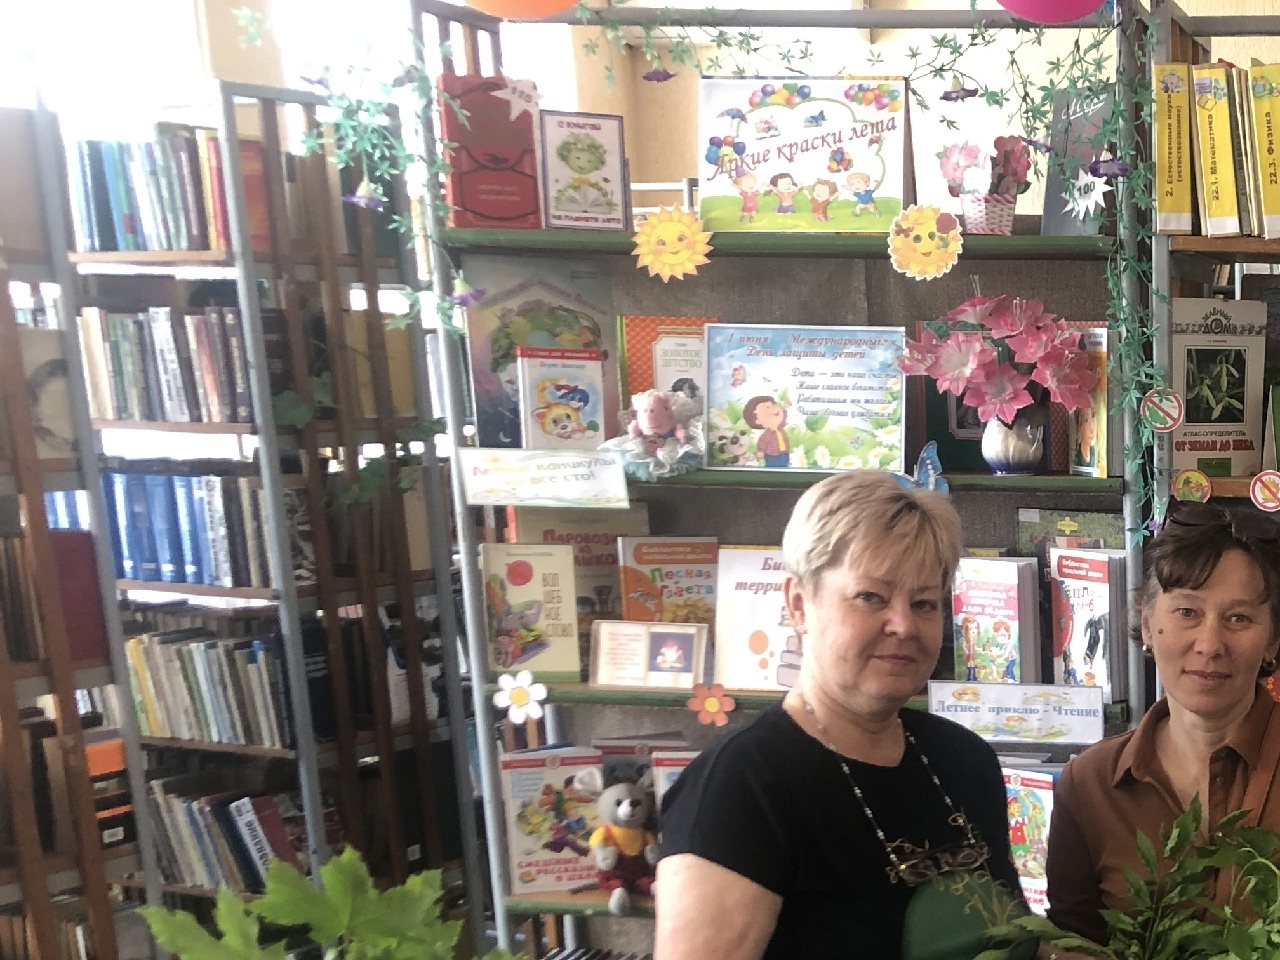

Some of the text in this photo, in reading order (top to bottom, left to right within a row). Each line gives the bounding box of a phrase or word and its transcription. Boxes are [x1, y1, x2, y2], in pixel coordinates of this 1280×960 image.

[707, 116, 897, 181] Яркие краски лета
[1207, 113, 1218, 175] Математика
[1265, 111, 1278, 185] 22.3. Физика
[1077, 181, 1096, 197] 100
[739, 334, 770, 344] июня
[784, 333, 892, 346] Международны
[746, 346, 867, 360] День защиты детей
[1183, 430, 1247, 438] АТЛАС-ОПРЕДЕЛИТЕЛЬ
[543, 529, 627, 544] ПАРОВОЗИ
[542, 572, 560, 587] ВОЛ
[935, 701, 1099, 717] Летнее приклю Чтение
